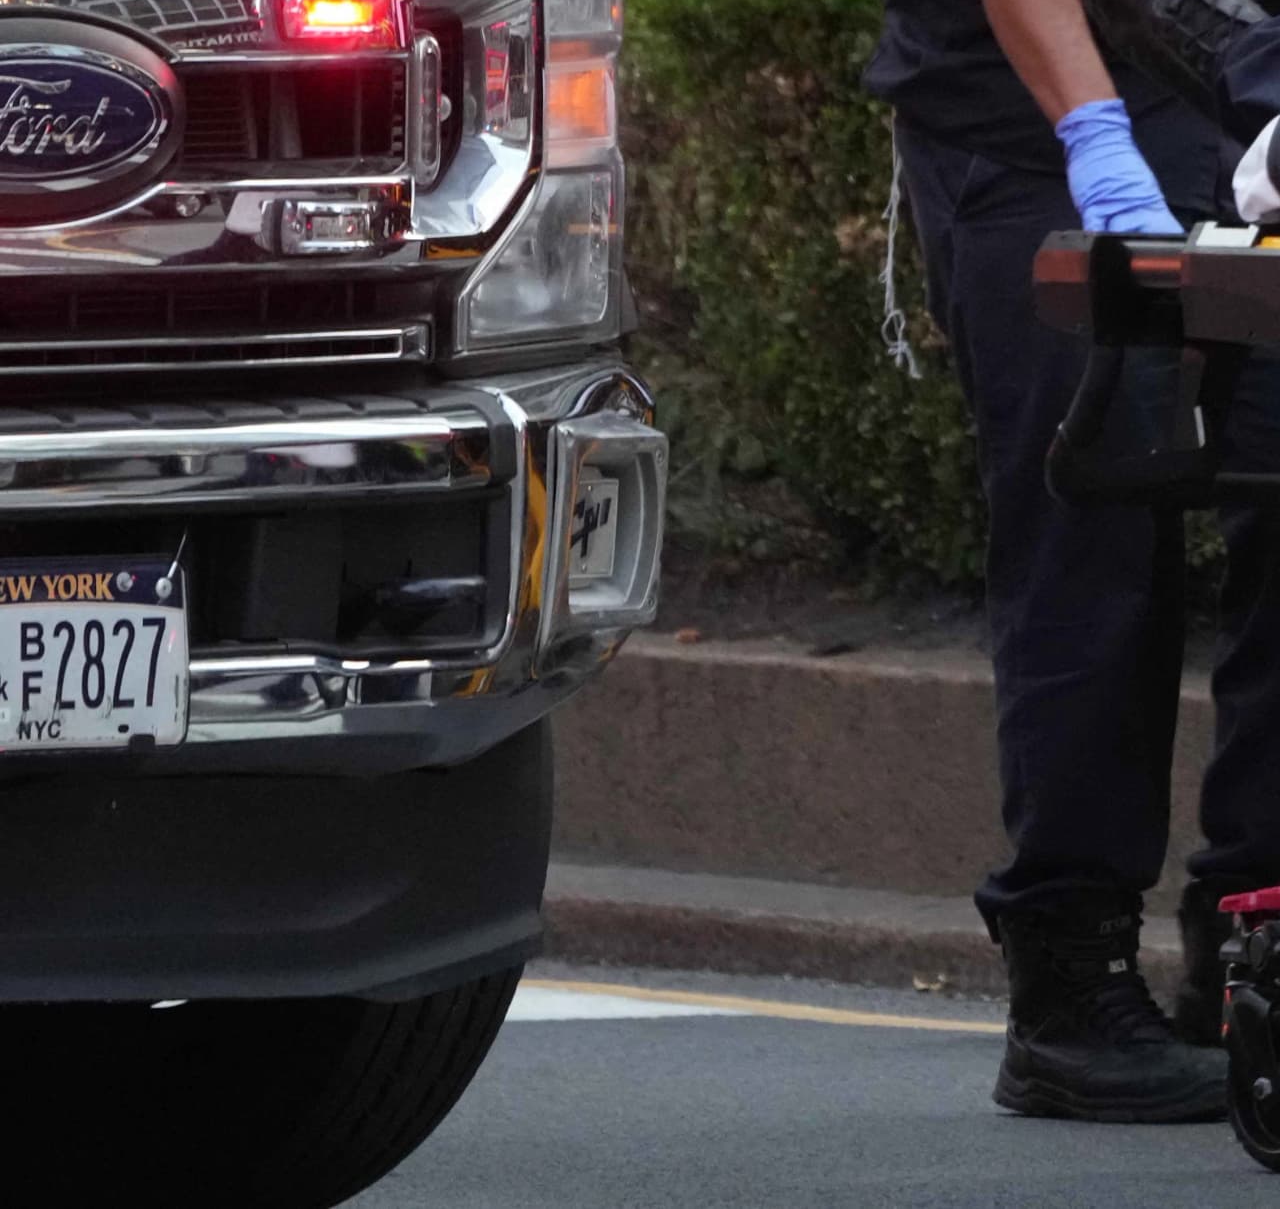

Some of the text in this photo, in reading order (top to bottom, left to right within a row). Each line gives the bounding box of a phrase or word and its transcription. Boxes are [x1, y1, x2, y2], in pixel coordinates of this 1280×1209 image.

[43, 573, 115, 600] YORK
[21, 622, 45, 661] B
[53, 617, 166, 710] 2827
[23, 671, 43, 711] F
[19, 719, 62, 740] NYC
